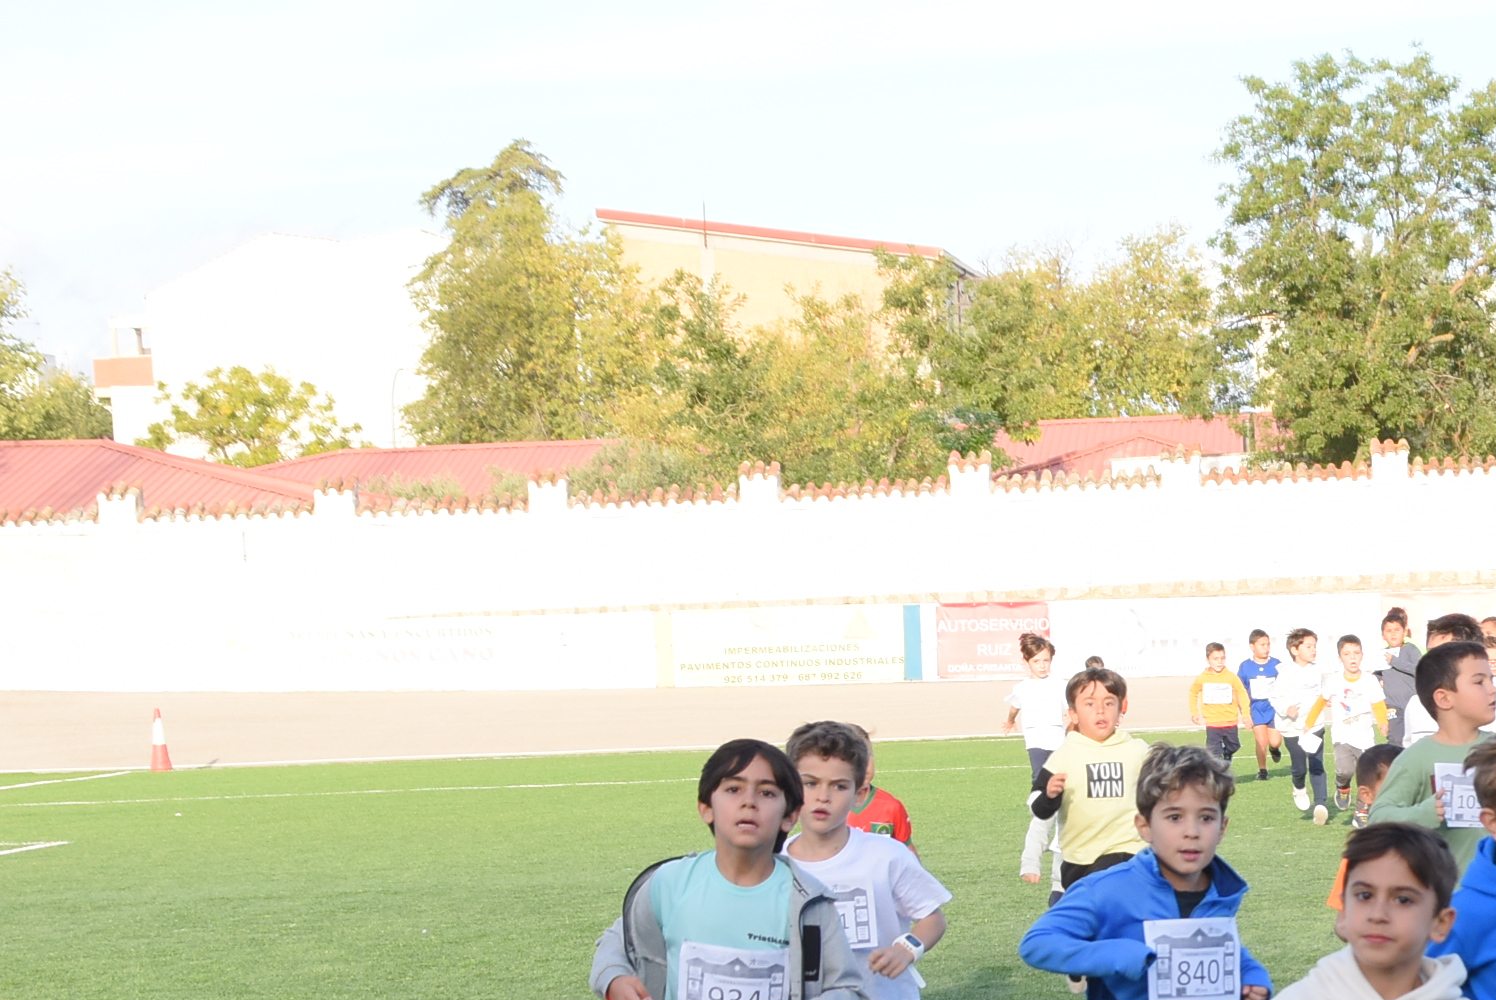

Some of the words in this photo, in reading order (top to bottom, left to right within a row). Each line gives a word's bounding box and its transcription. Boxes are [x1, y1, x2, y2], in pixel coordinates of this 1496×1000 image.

[936, 617, 1050, 634] AUTOSERVICIO
[723, 642, 861, 656] IMPERMEABILIZACIONES
[976, 643, 1012, 658] RUIZ
[679, 659, 753, 672] PAVIMENTOS
[754, 658, 822, 670] CONTINUOS
[824, 655, 905, 668] INDUSTRIALES
[722, 673, 744, 685] 926
[745, 673, 767, 685] 514
[819, 671, 841, 682] 992
[1089, 762, 1123, 781] YOU
[1089, 780, 1125, 799] WIN
[1176, 959, 1220, 986] 840
